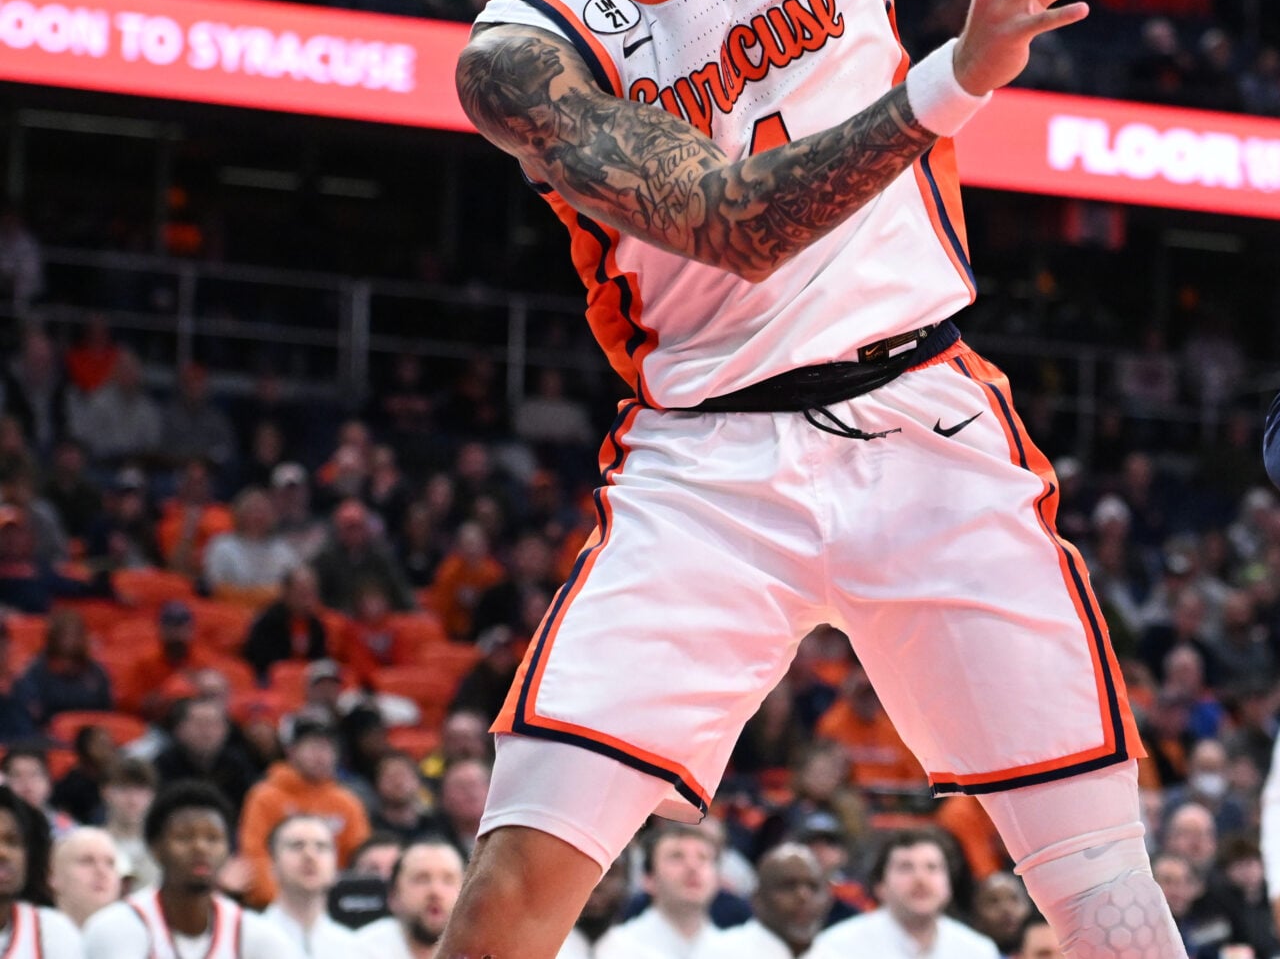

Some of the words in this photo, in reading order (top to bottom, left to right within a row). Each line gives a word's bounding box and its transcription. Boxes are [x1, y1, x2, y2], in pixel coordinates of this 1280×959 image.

[114, 10, 184, 66] TO
[186, 21, 417, 93] SYRACUSE
[605, 9, 630, 29] 21
[1047, 114, 1245, 189] FLOOR
